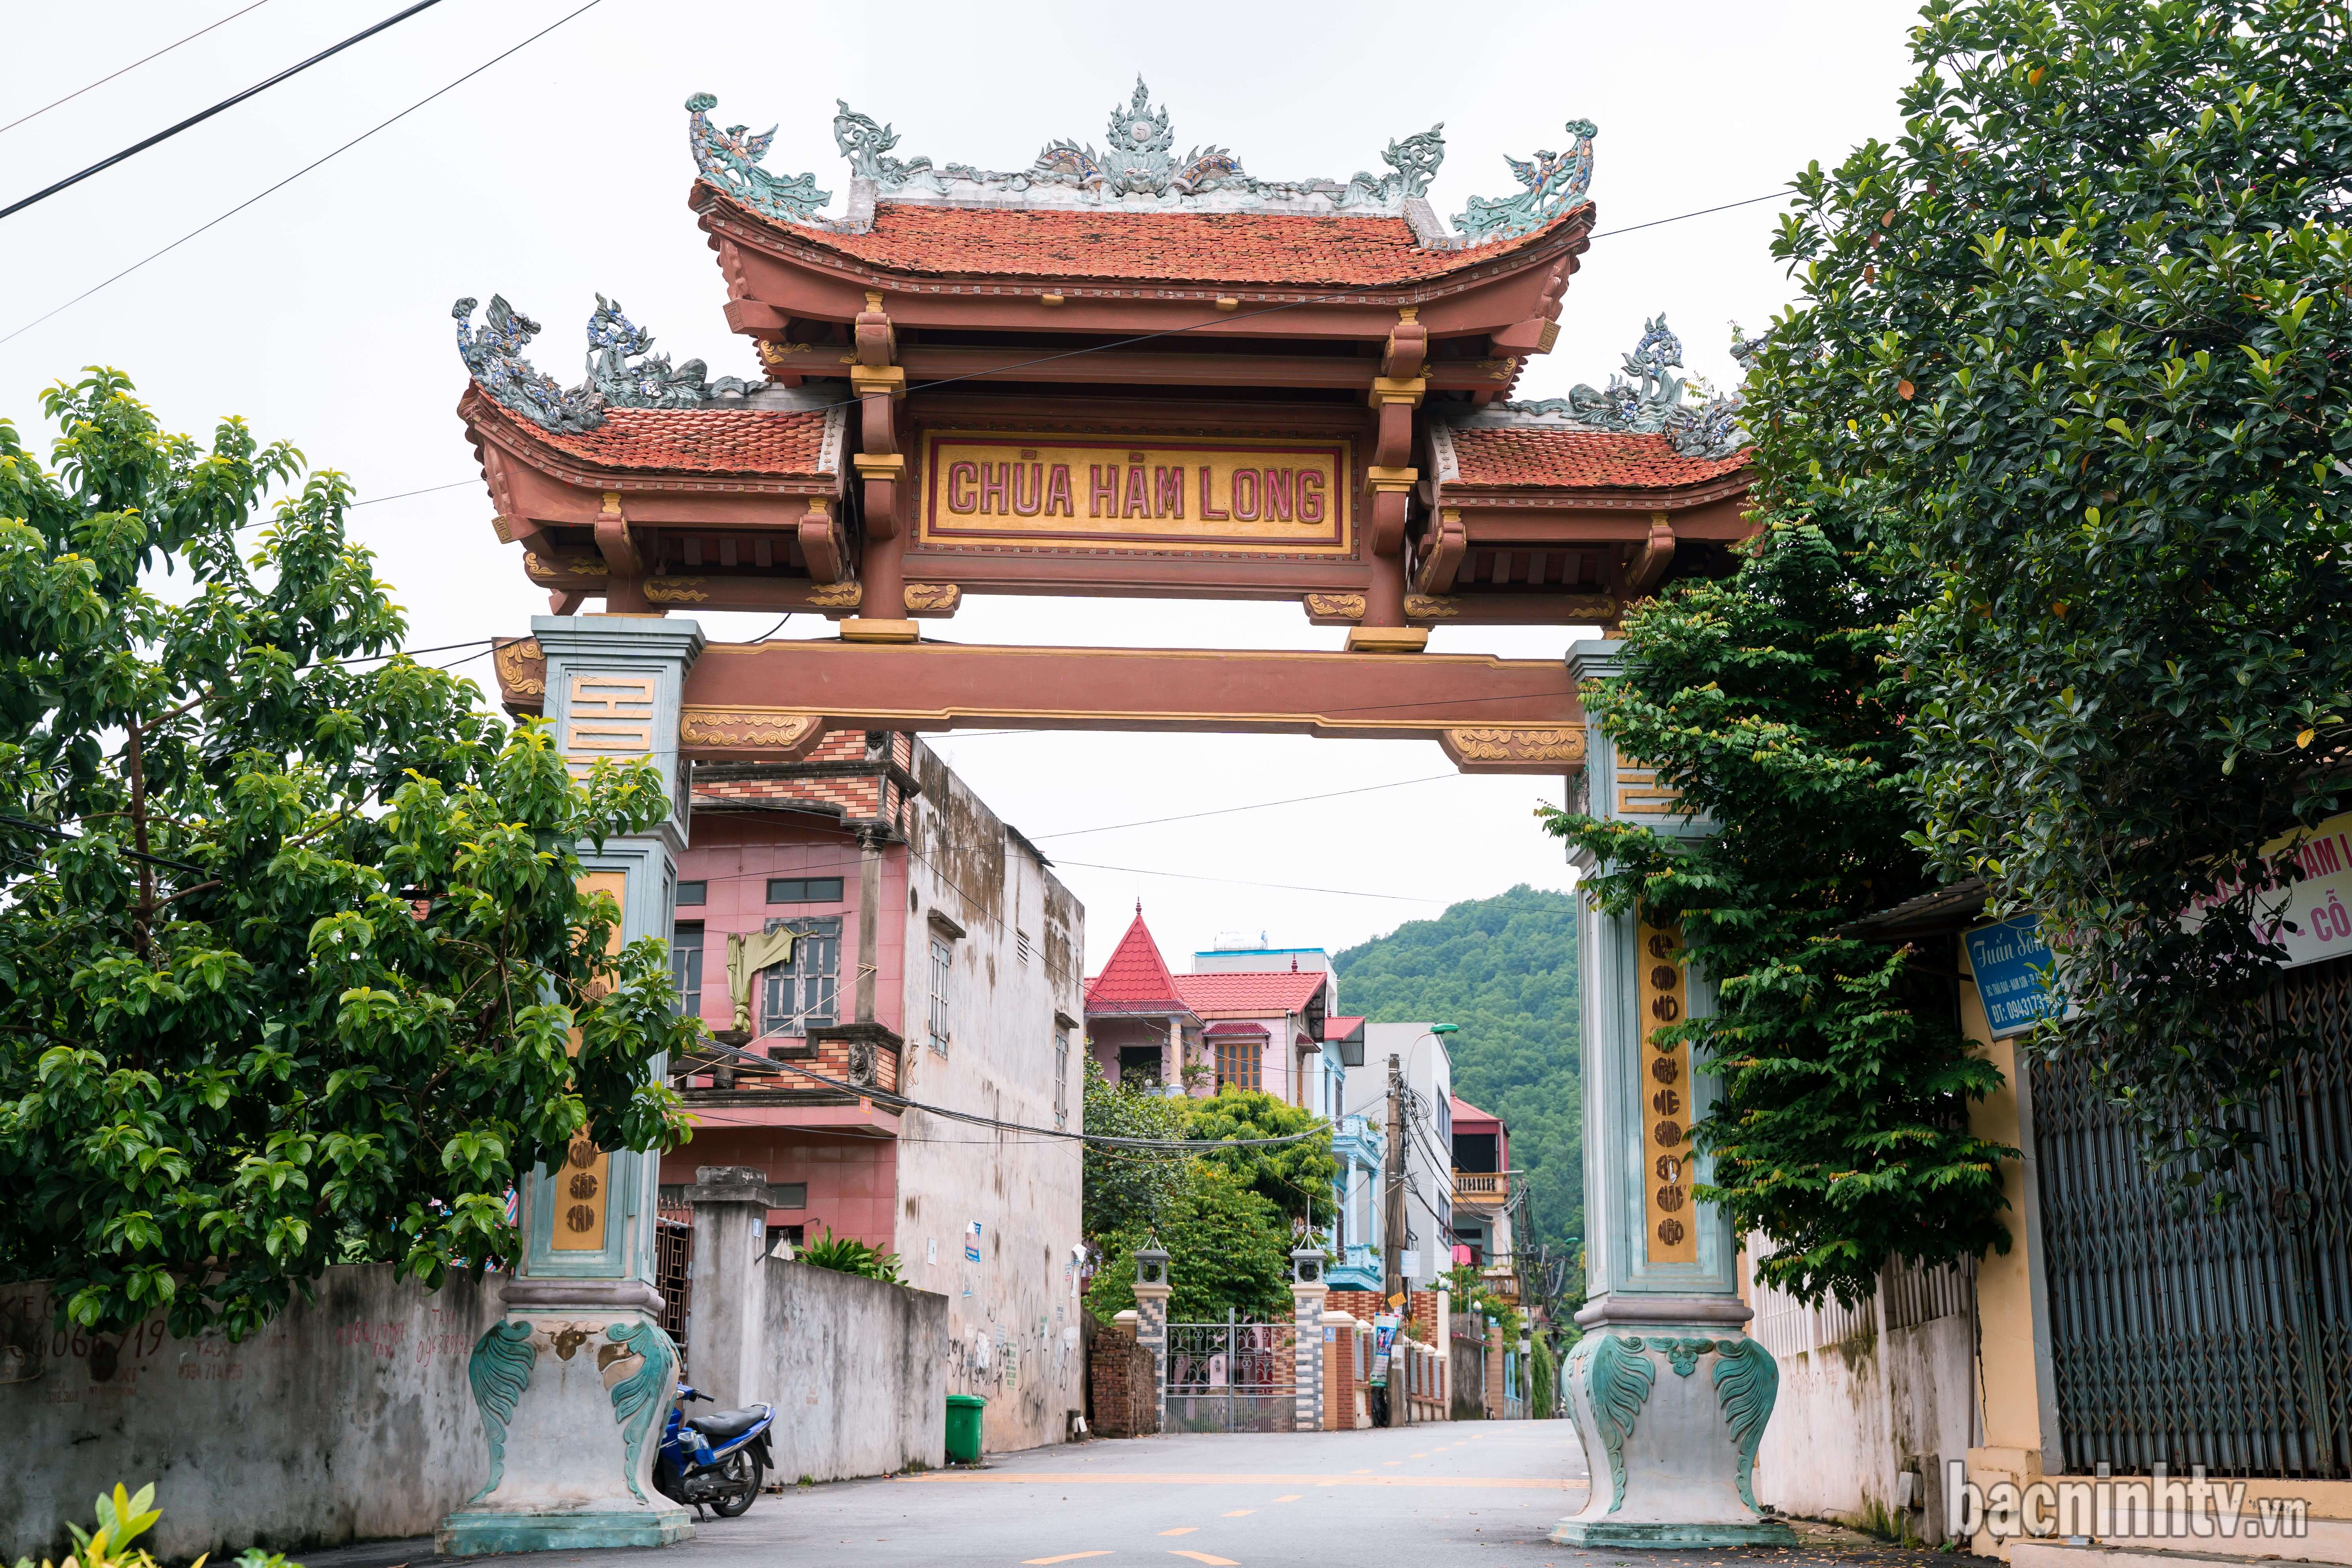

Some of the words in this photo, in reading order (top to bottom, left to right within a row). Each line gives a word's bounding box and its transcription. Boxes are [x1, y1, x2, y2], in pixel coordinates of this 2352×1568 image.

[949, 449, 1074, 517] CHÙA
[1089, 452, 1185, 519] HÀM
[1200, 466, 1324, 523] LONG
[2310, 888, 2352, 942] CỖ
[1973, 933, 2015, 968] Tuấn
[2009, 977, 2021, 991] NAM
[1991, 1004, 2007, 1023] ĐT:
